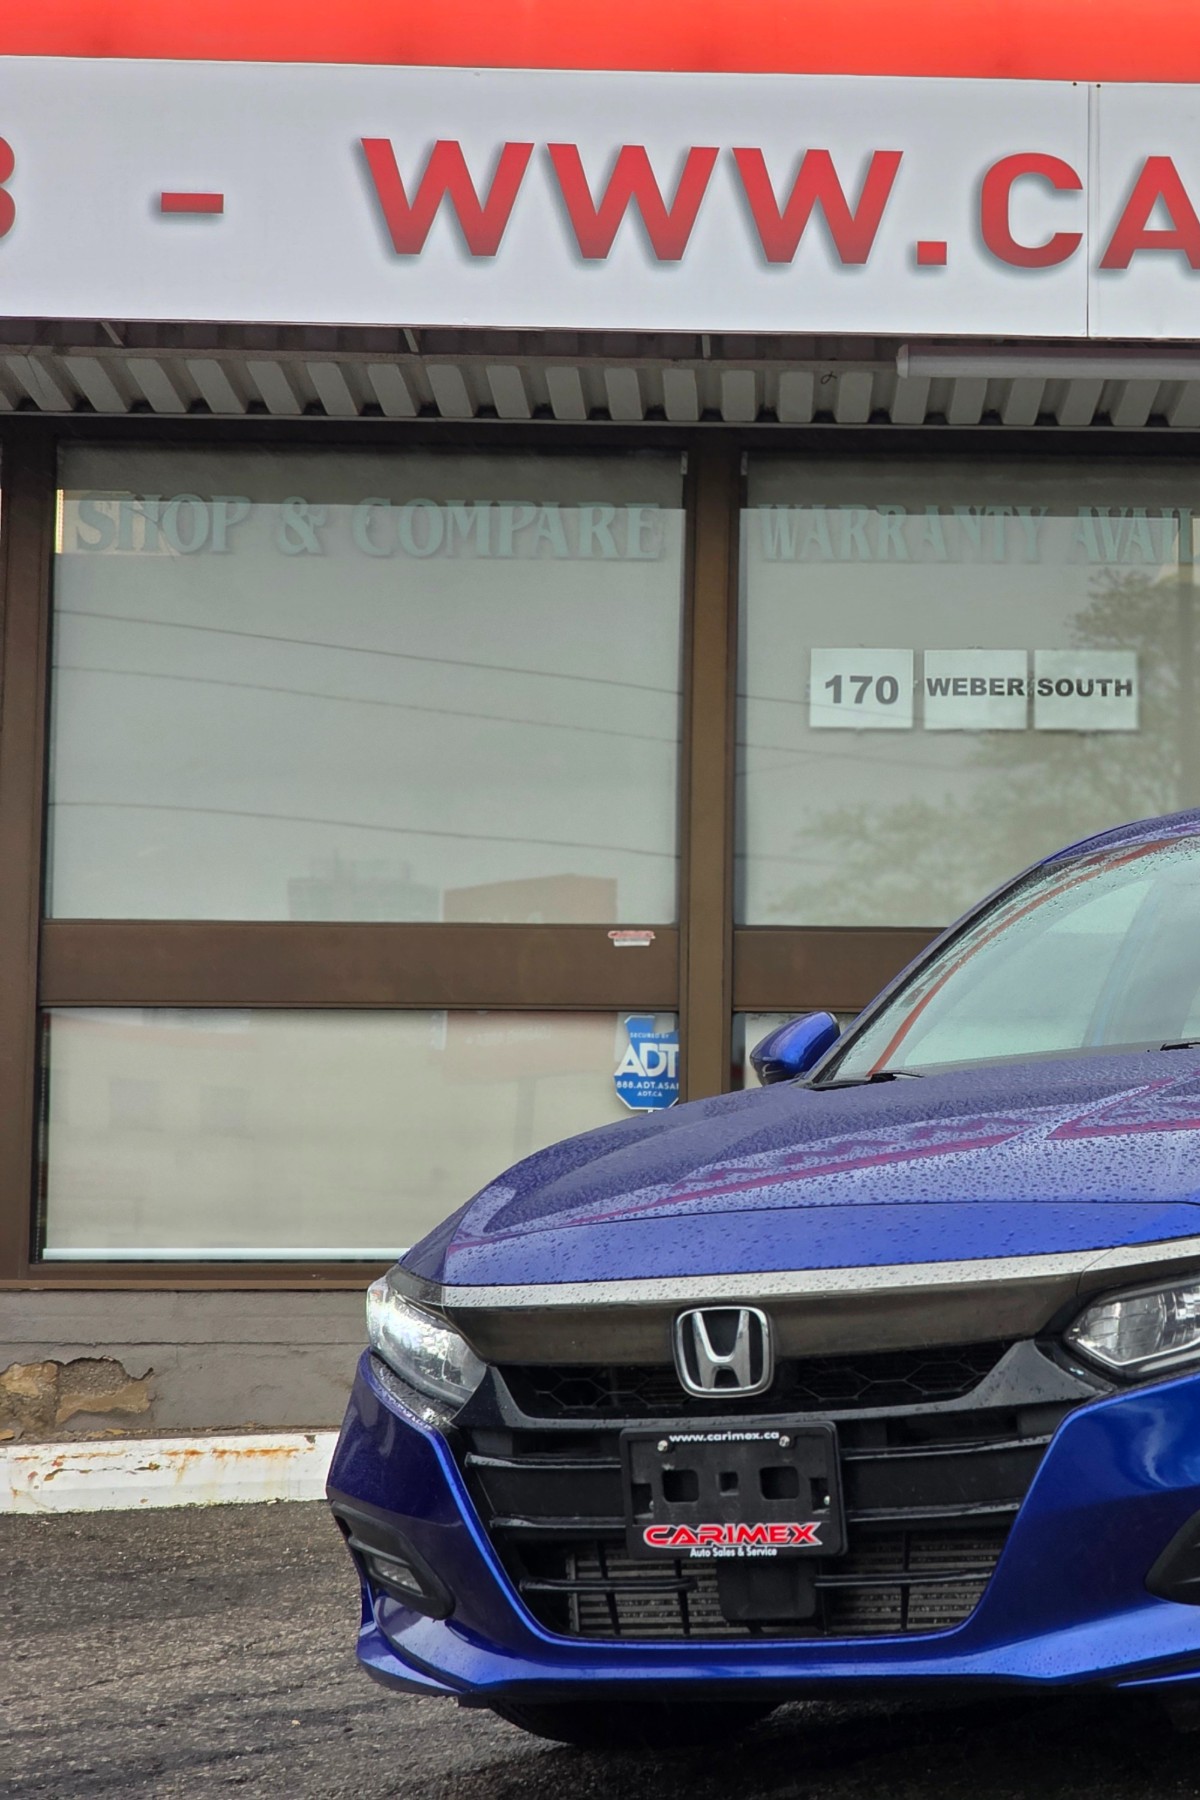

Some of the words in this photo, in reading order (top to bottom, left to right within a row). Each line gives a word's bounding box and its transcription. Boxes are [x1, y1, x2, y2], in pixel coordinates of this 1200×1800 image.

[77, 493, 251, 555] SHOP
[278, 495, 327, 555] &
[353, 497, 661, 559] COMPARE
[757, 503, 1050, 561] WARRANTY
[824, 675, 900, 705] 170
[926, 677, 1025, 696] WEBER
[1037, 678, 1133, 698] SOUTH
[614, 1042, 679, 1078] ADT
[669, 1431, 780, 1442] www.carimex.ca
[643, 1522, 823, 1548] CARIMEX
[690, 1548, 709, 1557] Auto
[712, 1548, 735, 1557] Sales
[738, 1547, 745, 1556] &
[747, 1546, 778, 1556] Service
